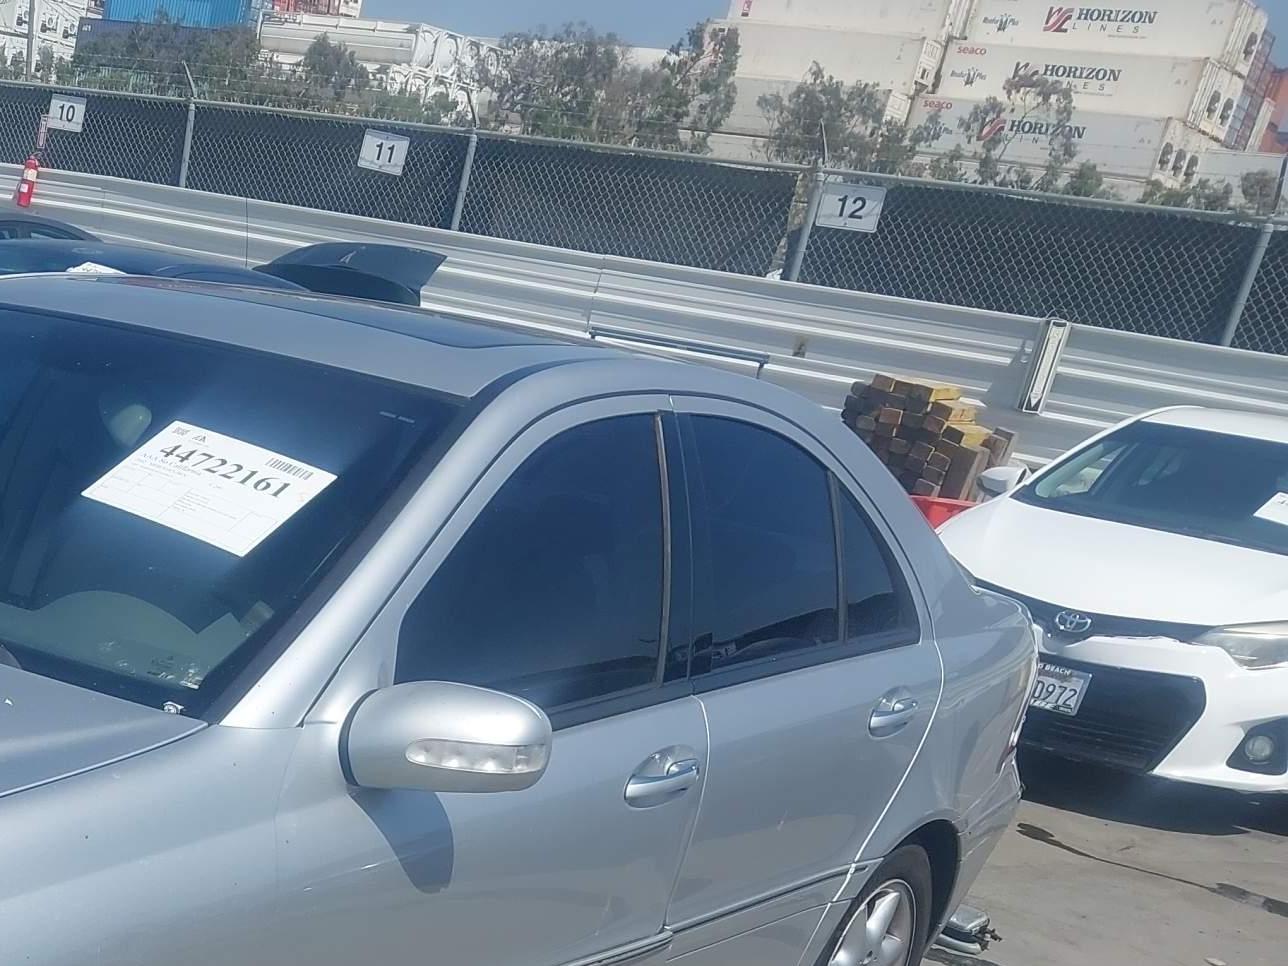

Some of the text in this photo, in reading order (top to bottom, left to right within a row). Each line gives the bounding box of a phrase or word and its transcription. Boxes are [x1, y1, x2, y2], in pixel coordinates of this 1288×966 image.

[1076, 7, 1159, 24] HORIZON
[1072, 22, 1139, 34] LINES
[956, 45, 987, 56] seaco
[1042, 64, 1122, 82] HORIZON
[1065, 80, 1106, 91] NES
[58, 103, 76, 123] 10
[922, 99, 953, 110] seaco
[375, 141, 396, 164] 11
[837, 194, 867, 220] 12
[159, 444, 291, 499] 44722161
[1045, 663, 1072, 675] BEACH
